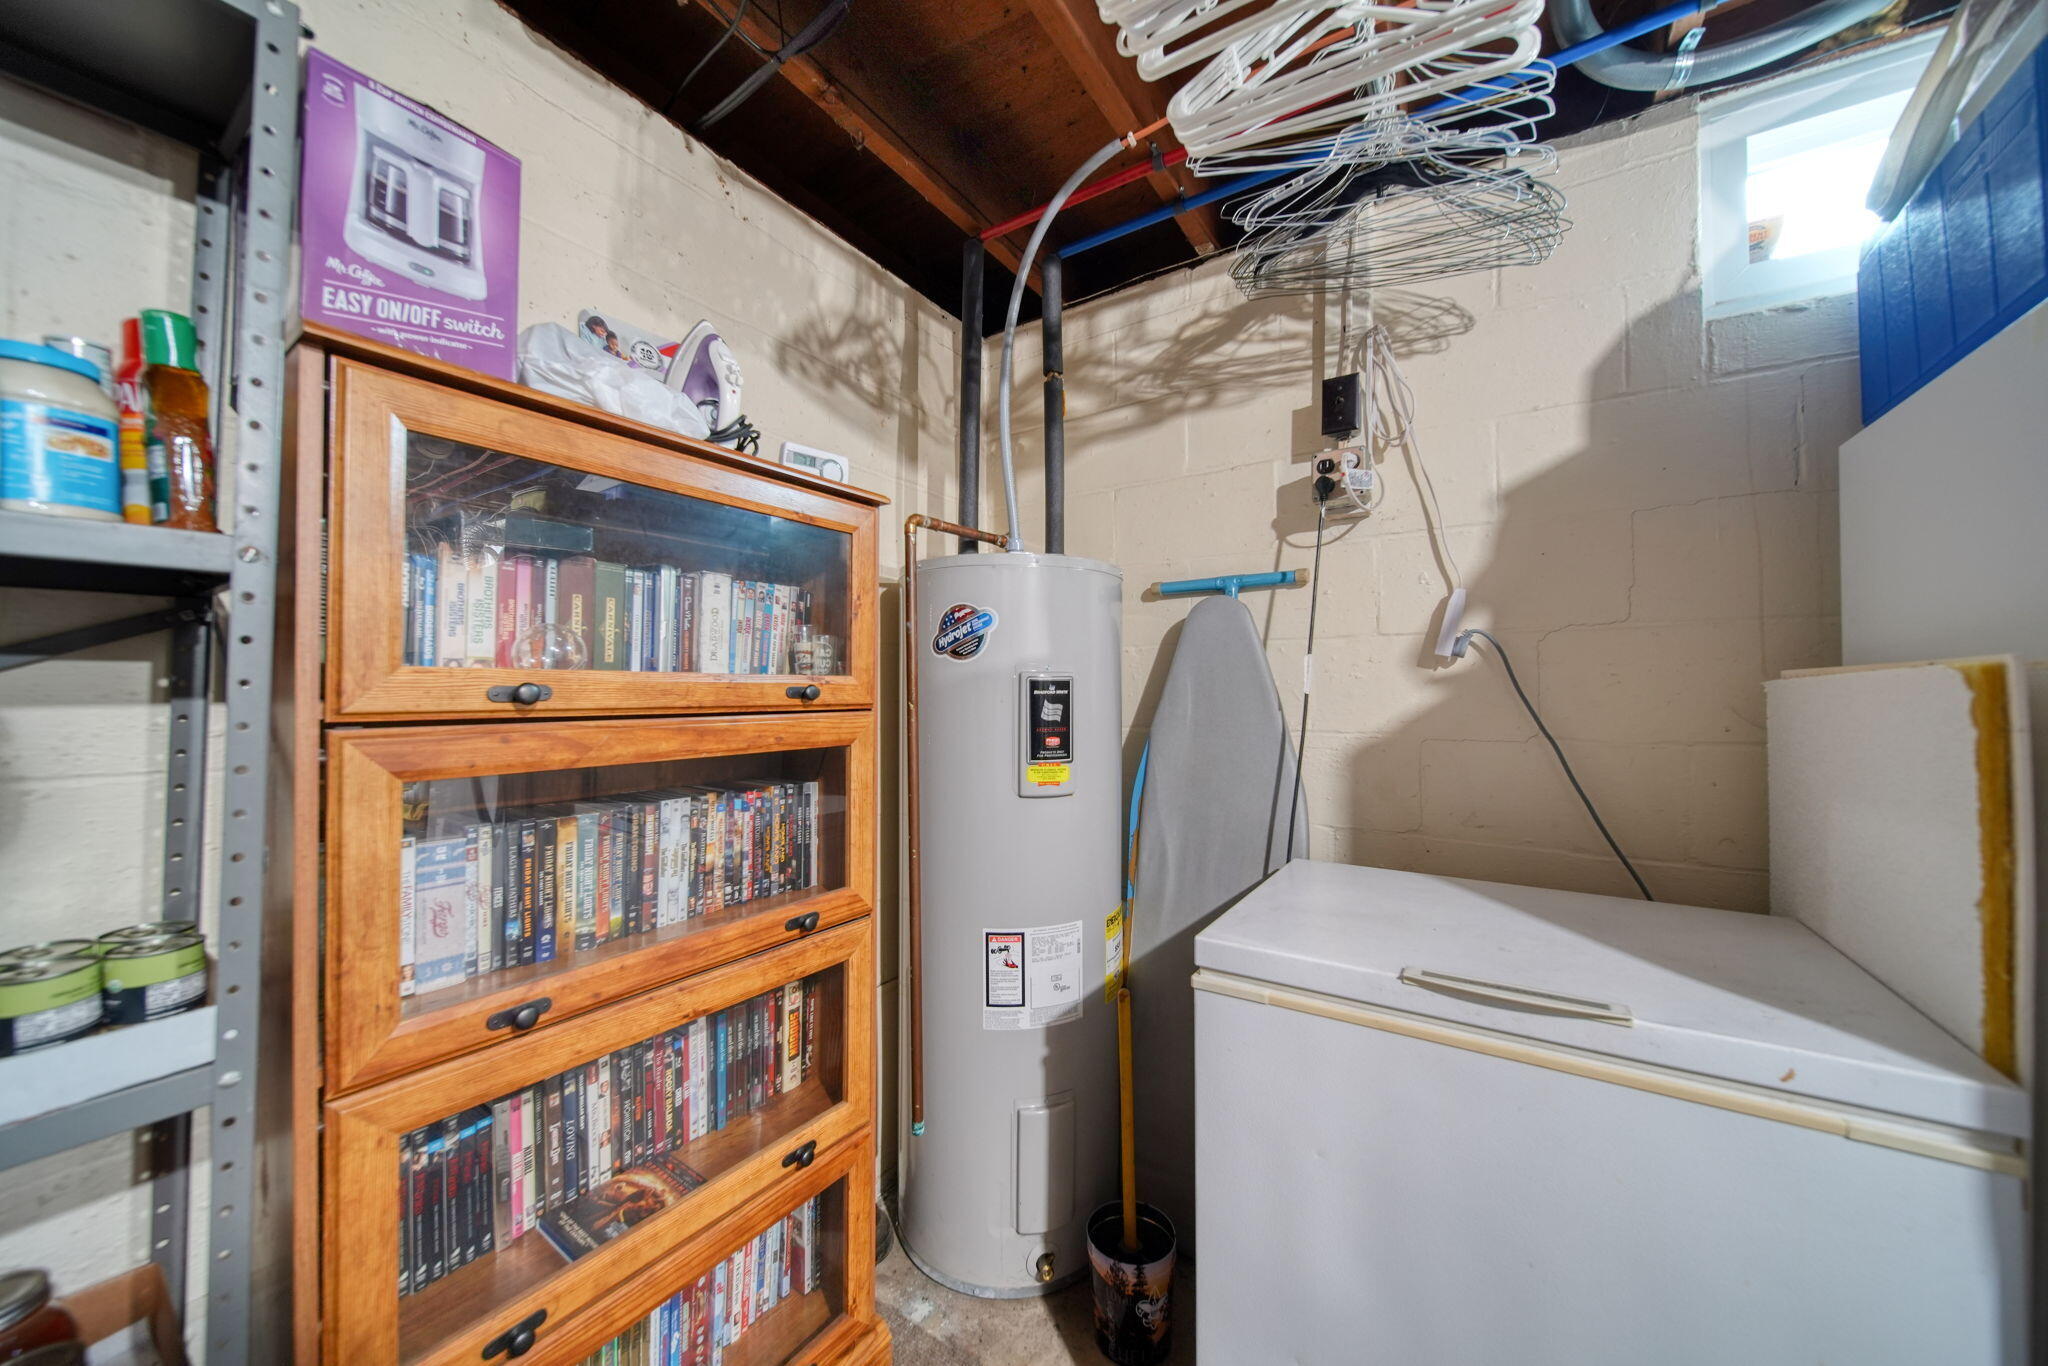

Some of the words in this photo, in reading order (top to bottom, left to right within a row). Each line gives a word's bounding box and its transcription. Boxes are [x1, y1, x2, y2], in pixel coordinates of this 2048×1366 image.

[347, 263, 386, 287] Coffee
[322, 285, 374, 315] EASY
[376, 297, 442, 328] ON/OFF
[443, 316, 505, 340] switch
[484, 576, 493, 629] BROTHERS
[938, 620, 972, 648] Hydrojet
[544, 845, 554, 872] FRIDAY
[565, 841, 573, 868] FRIDAY
[584, 838, 593, 865] FRIDAY
[602, 835, 610, 861] FRIDAY
[616, 833, 624, 858] FRIDAY
[524, 858, 532, 884] FRIDAY
[565, 870, 573, 893] NIGHT
[584, 867, 593, 890] NIGHT
[615, 860, 623, 882] NIGHT
[524, 887, 532, 909] NIGHT
[543, 875, 554, 898] NIGHT
[402, 884, 414, 918] FAMILY
[564, 896, 573, 923] LIGHTS
[583, 892, 593, 919] LIGHTS
[431, 897, 455, 938] Fargo
[524, 911, 532, 937] LIGHTS
[543, 901, 554, 929] LIGHTS
[789, 1012, 800, 1057] SHOGUN
[623, 1099, 631, 1142] PROHIBITION
[565, 1120, 575, 1161] LOVING
